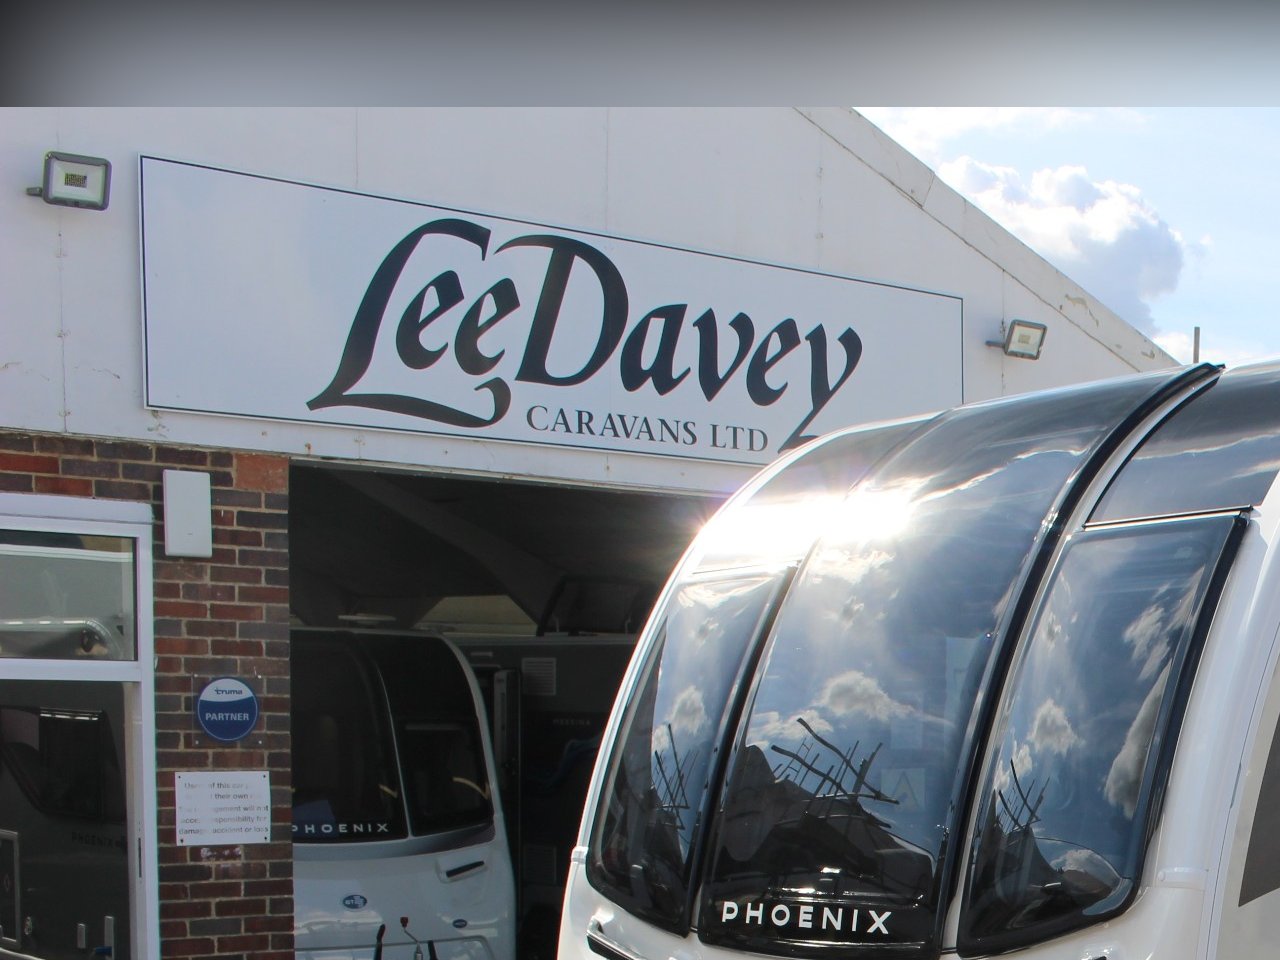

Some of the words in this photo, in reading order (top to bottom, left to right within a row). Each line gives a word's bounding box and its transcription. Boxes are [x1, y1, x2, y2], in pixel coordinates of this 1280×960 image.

[526, 404, 699, 448] CARAVANS
[709, 424, 770, 454] LTD
[214, 687, 243, 696] truma
[205, 712, 250, 722] PARTNER
[216, 782, 231, 790] this
[212, 816, 254, 825] sponsibility
[722, 901, 892, 935] PHOENIX
